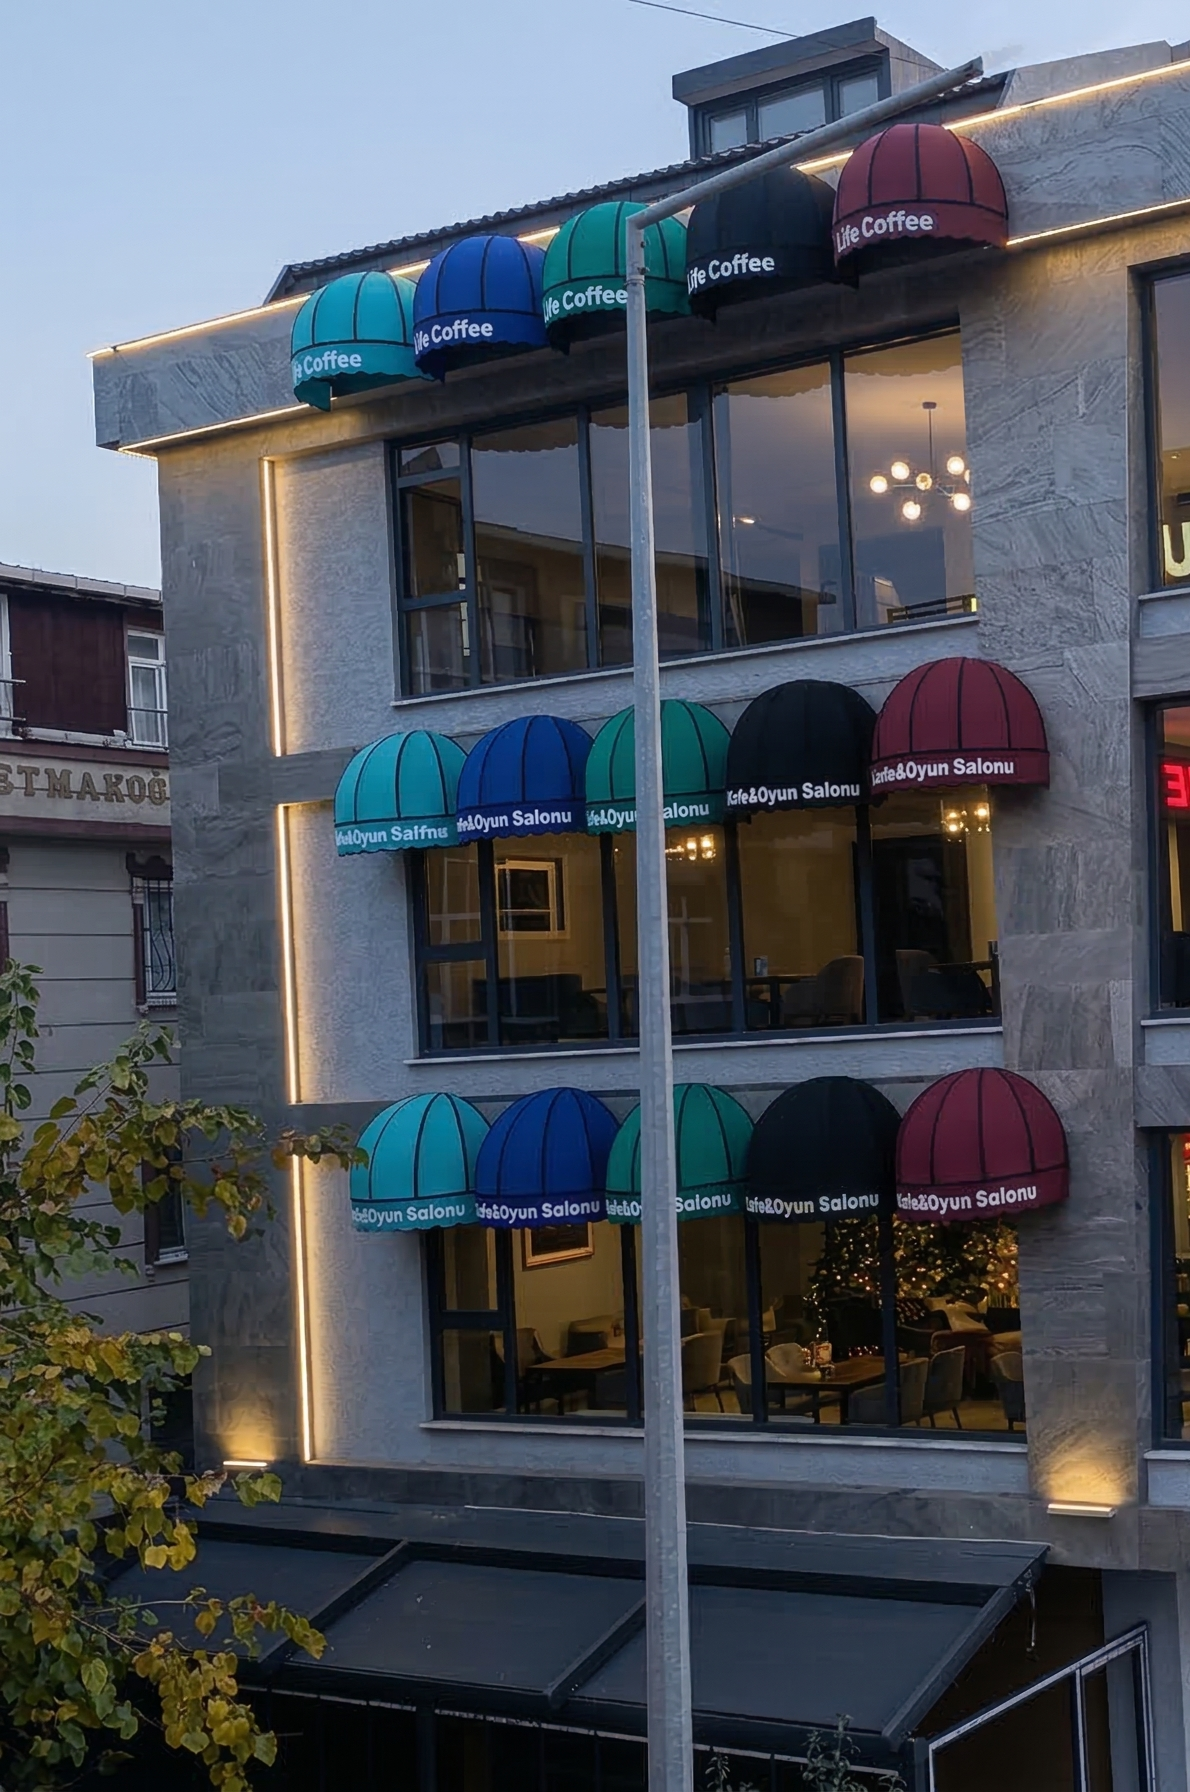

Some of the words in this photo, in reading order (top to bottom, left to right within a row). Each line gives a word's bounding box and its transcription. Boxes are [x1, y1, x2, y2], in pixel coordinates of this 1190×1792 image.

[836, 224, 860, 254] Life
[861, 210, 934, 239] Coffee
[687, 267, 706, 296] Life
[708, 252, 776, 279] Coffee
[562, 286, 629, 311] Coffee
[431, 319, 494, 344] Coffee
[303, 350, 362, 376] Coffee
[953, 756, 1015, 776] Salonu
[801, 781, 861, 799] Salonu
[512, 808, 572, 827] Salonu
[662, 801, 710, 819] alonu
[675, 1193, 732, 1213] Salonu
[819, 1193, 880, 1213] Salonu
[975, 1185, 1037, 1208] Salonu
[406, 1203, 466, 1221] Salonu
[541, 1199, 601, 1218] Salonu
